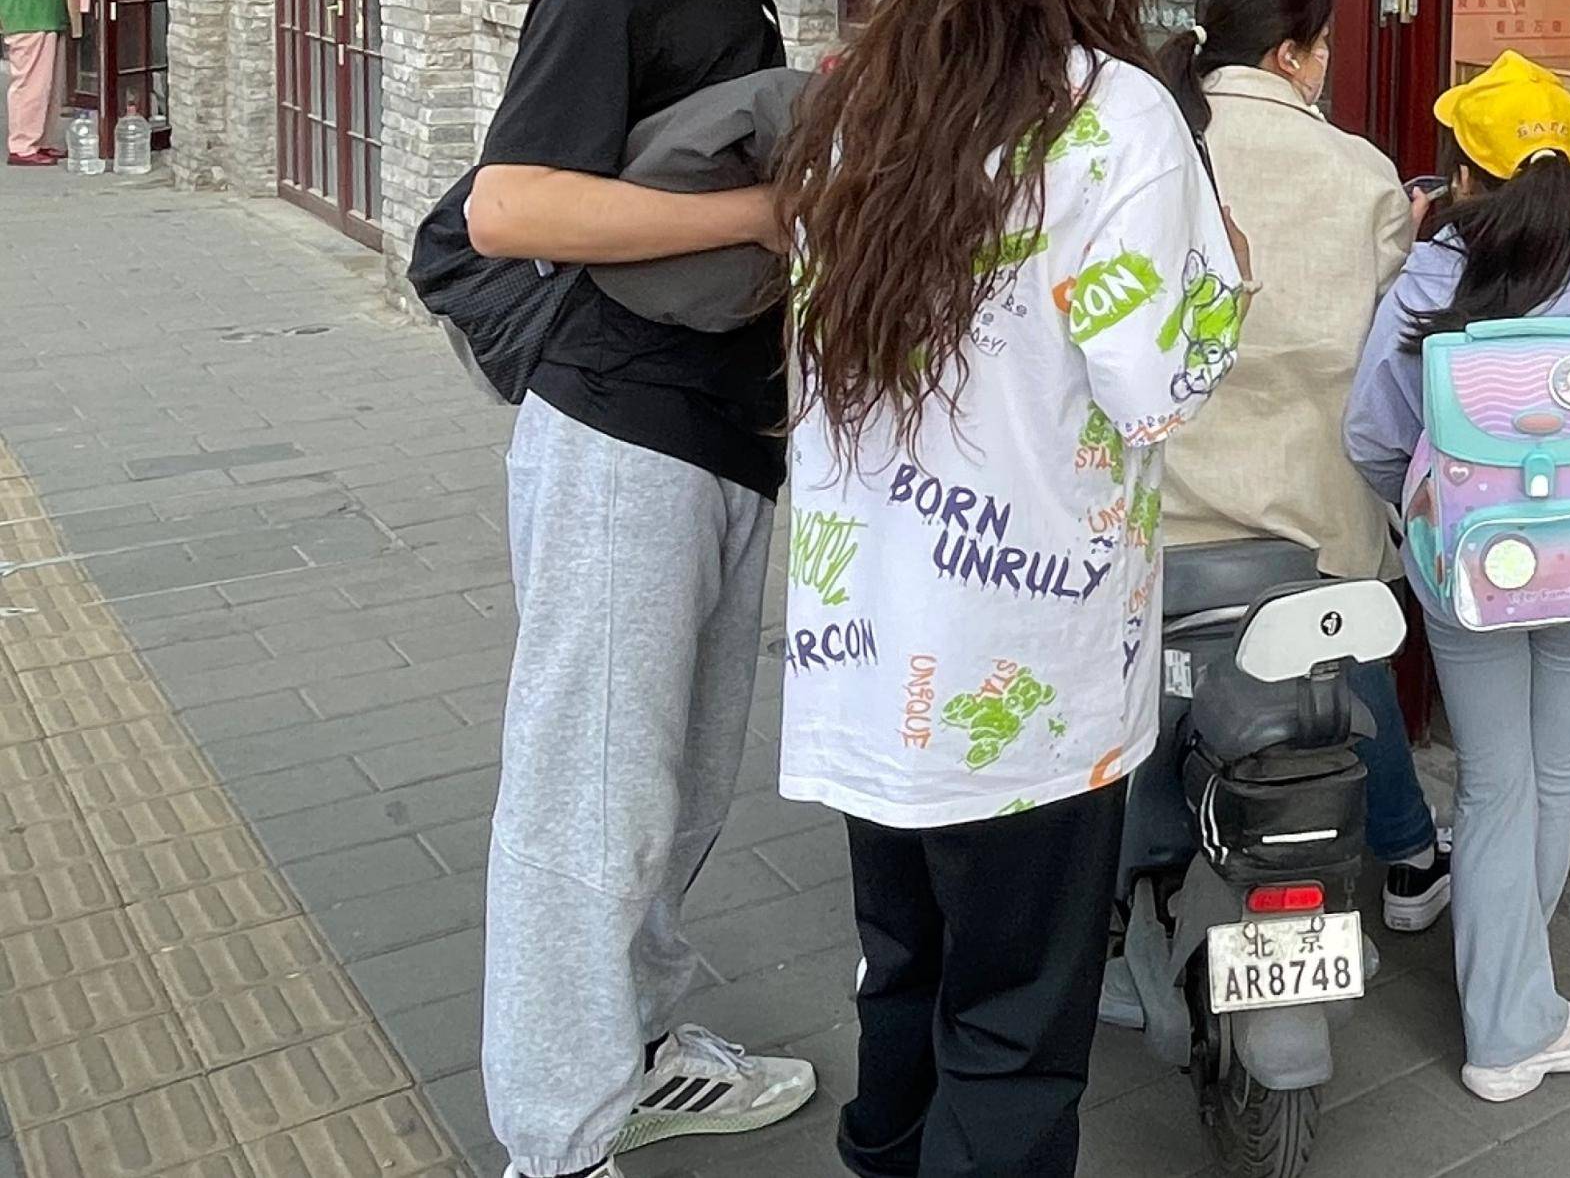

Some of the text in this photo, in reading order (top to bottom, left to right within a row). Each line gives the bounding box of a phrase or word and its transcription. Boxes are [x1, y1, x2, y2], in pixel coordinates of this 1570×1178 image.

[889, 463, 1011, 544] BORN
[933, 529, 1112, 604] UNRULY
[1224, 956, 1352, 1002] AR8748
